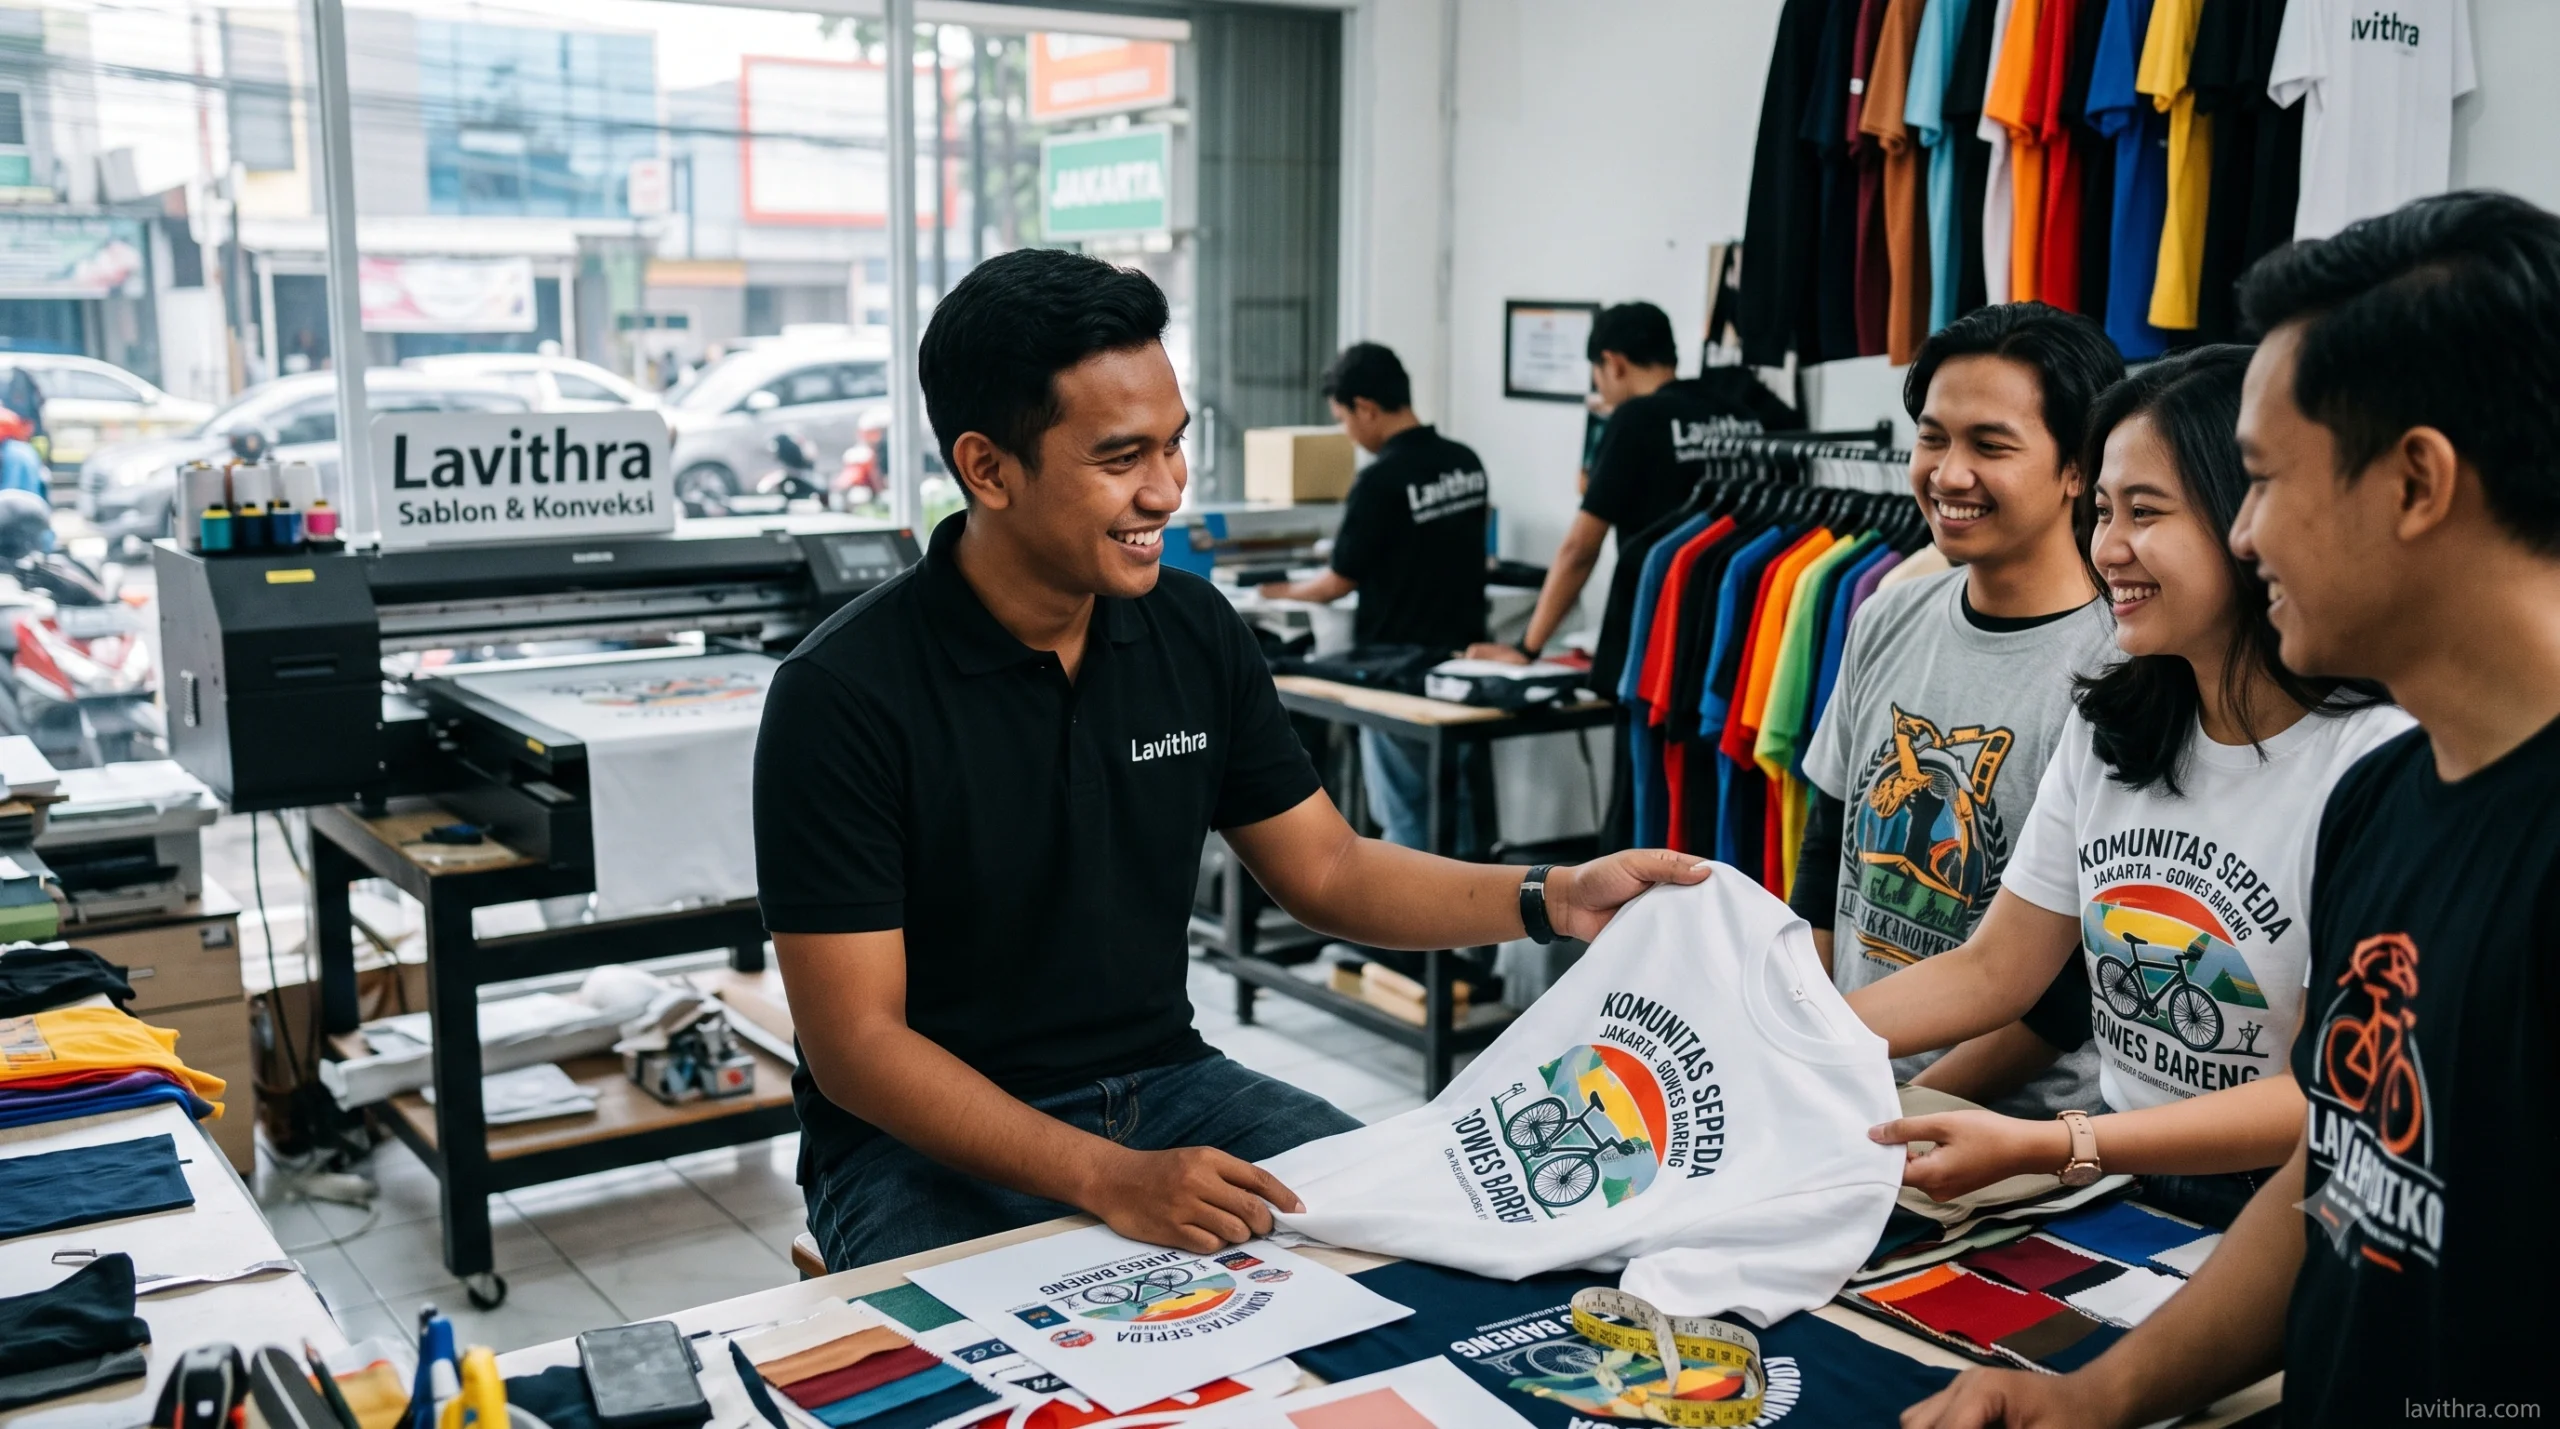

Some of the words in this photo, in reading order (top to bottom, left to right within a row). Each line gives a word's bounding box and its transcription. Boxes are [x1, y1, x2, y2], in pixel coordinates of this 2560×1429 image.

[1052, 161, 1165, 210] JAKARTA
[394, 427, 651, 489] Lavithra
[399, 498, 497, 525] Sablon
[505, 497, 524, 519] &
[534, 491, 654, 518] Konveksi
[1131, 730, 1207, 762] Lavithra
[2078, 828, 2218, 873] KOMUNITAS
[2216, 852, 2292, 944] SEPEDA
[2093, 863, 2152, 889] JAKARTA
[2165, 867, 2213, 898] GOWES
[2208, 889, 2253, 942] BARENG
[1600, 1024, 1657, 1061] JAKARTA
[1600, 991, 1714, 1083] KOMUNITAS
[1686, 1084, 1725, 1180] SEPEDA
[1656, 1060, 1686, 1108] GOWES
[1668, 1110, 1690, 1169] BARENG
[1039, 1269, 1118, 1296] BARENG
[1116, 1327, 1193, 1343] SEPEDA
[1450, 1318, 1567, 1359] BARENG
